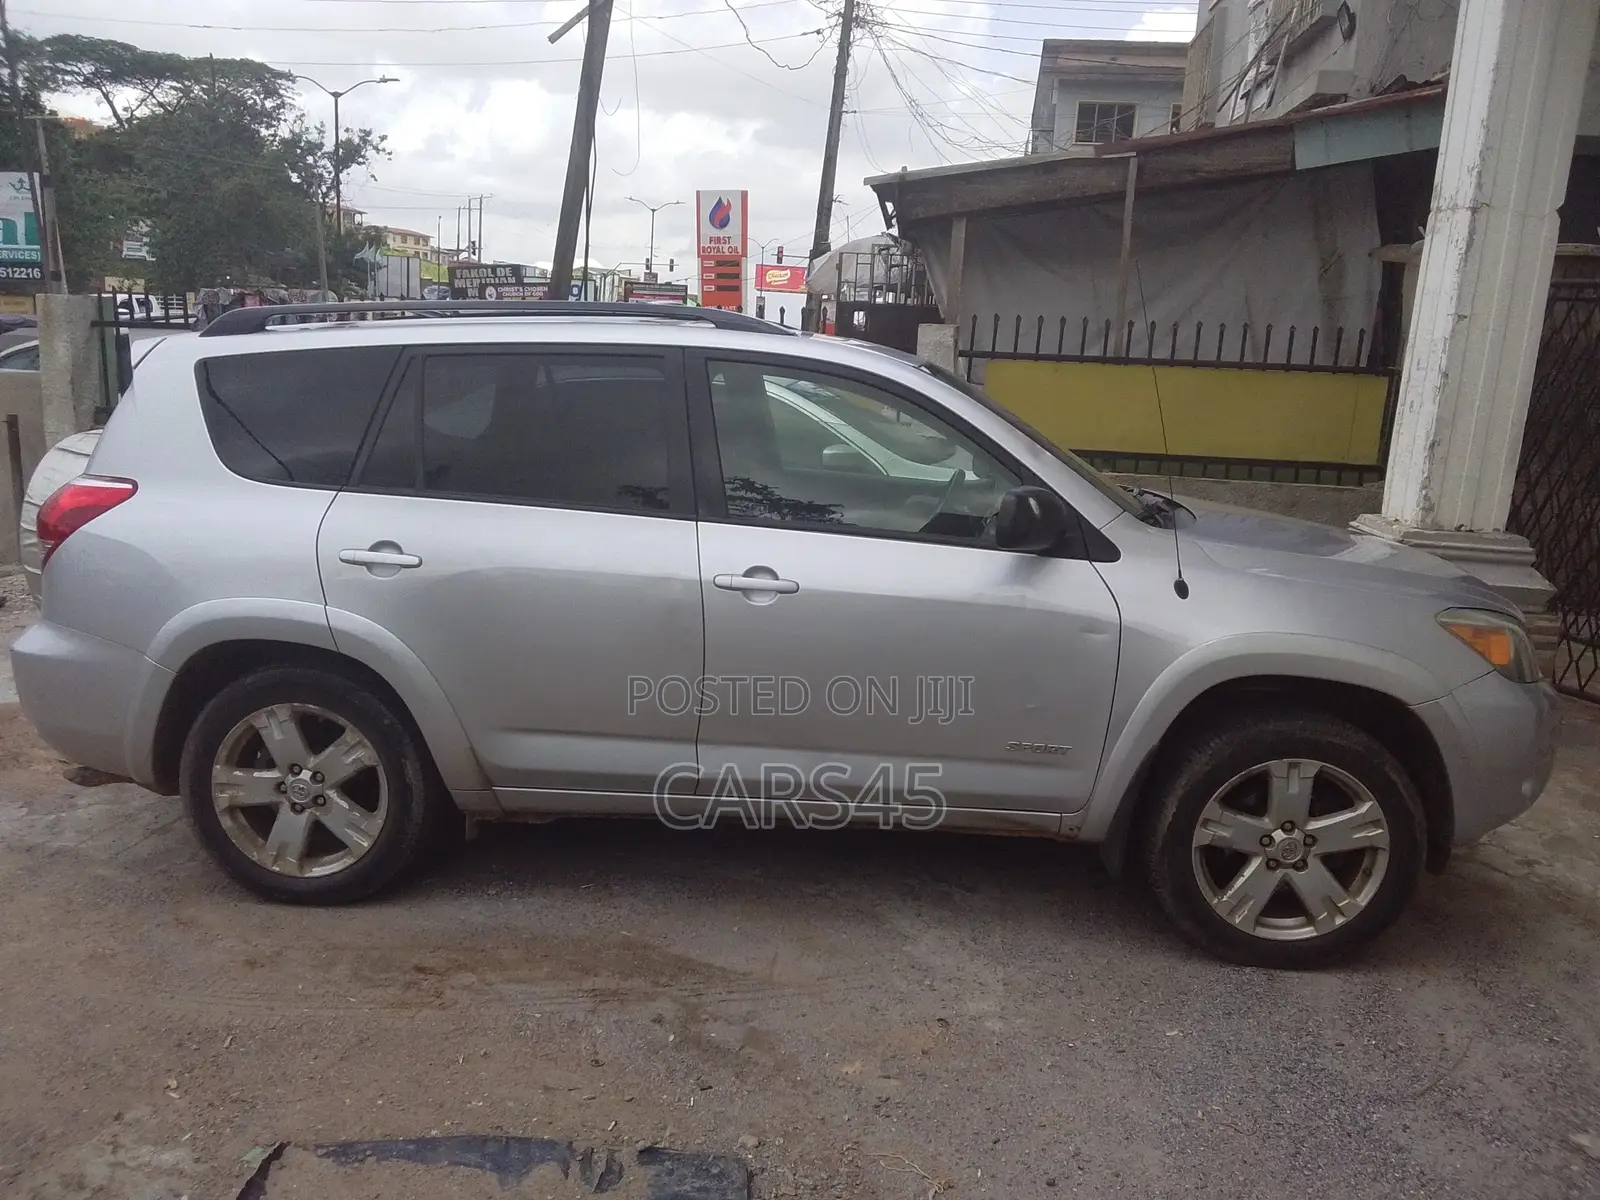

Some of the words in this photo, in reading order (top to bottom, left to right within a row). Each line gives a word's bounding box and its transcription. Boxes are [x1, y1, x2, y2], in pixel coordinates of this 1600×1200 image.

[708, 235, 732, 245] FIRST
[701, 245, 726, 254] ROYAL
[727, 245, 740, 254] OIL
[0, 250, 41, 262] RVICES)
[0, 267, 41, 279] 512216
[455, 268, 495, 278] FAKOL
[496, 267, 513, 277] DE
[1005, 741, 1073, 755] SPORT
